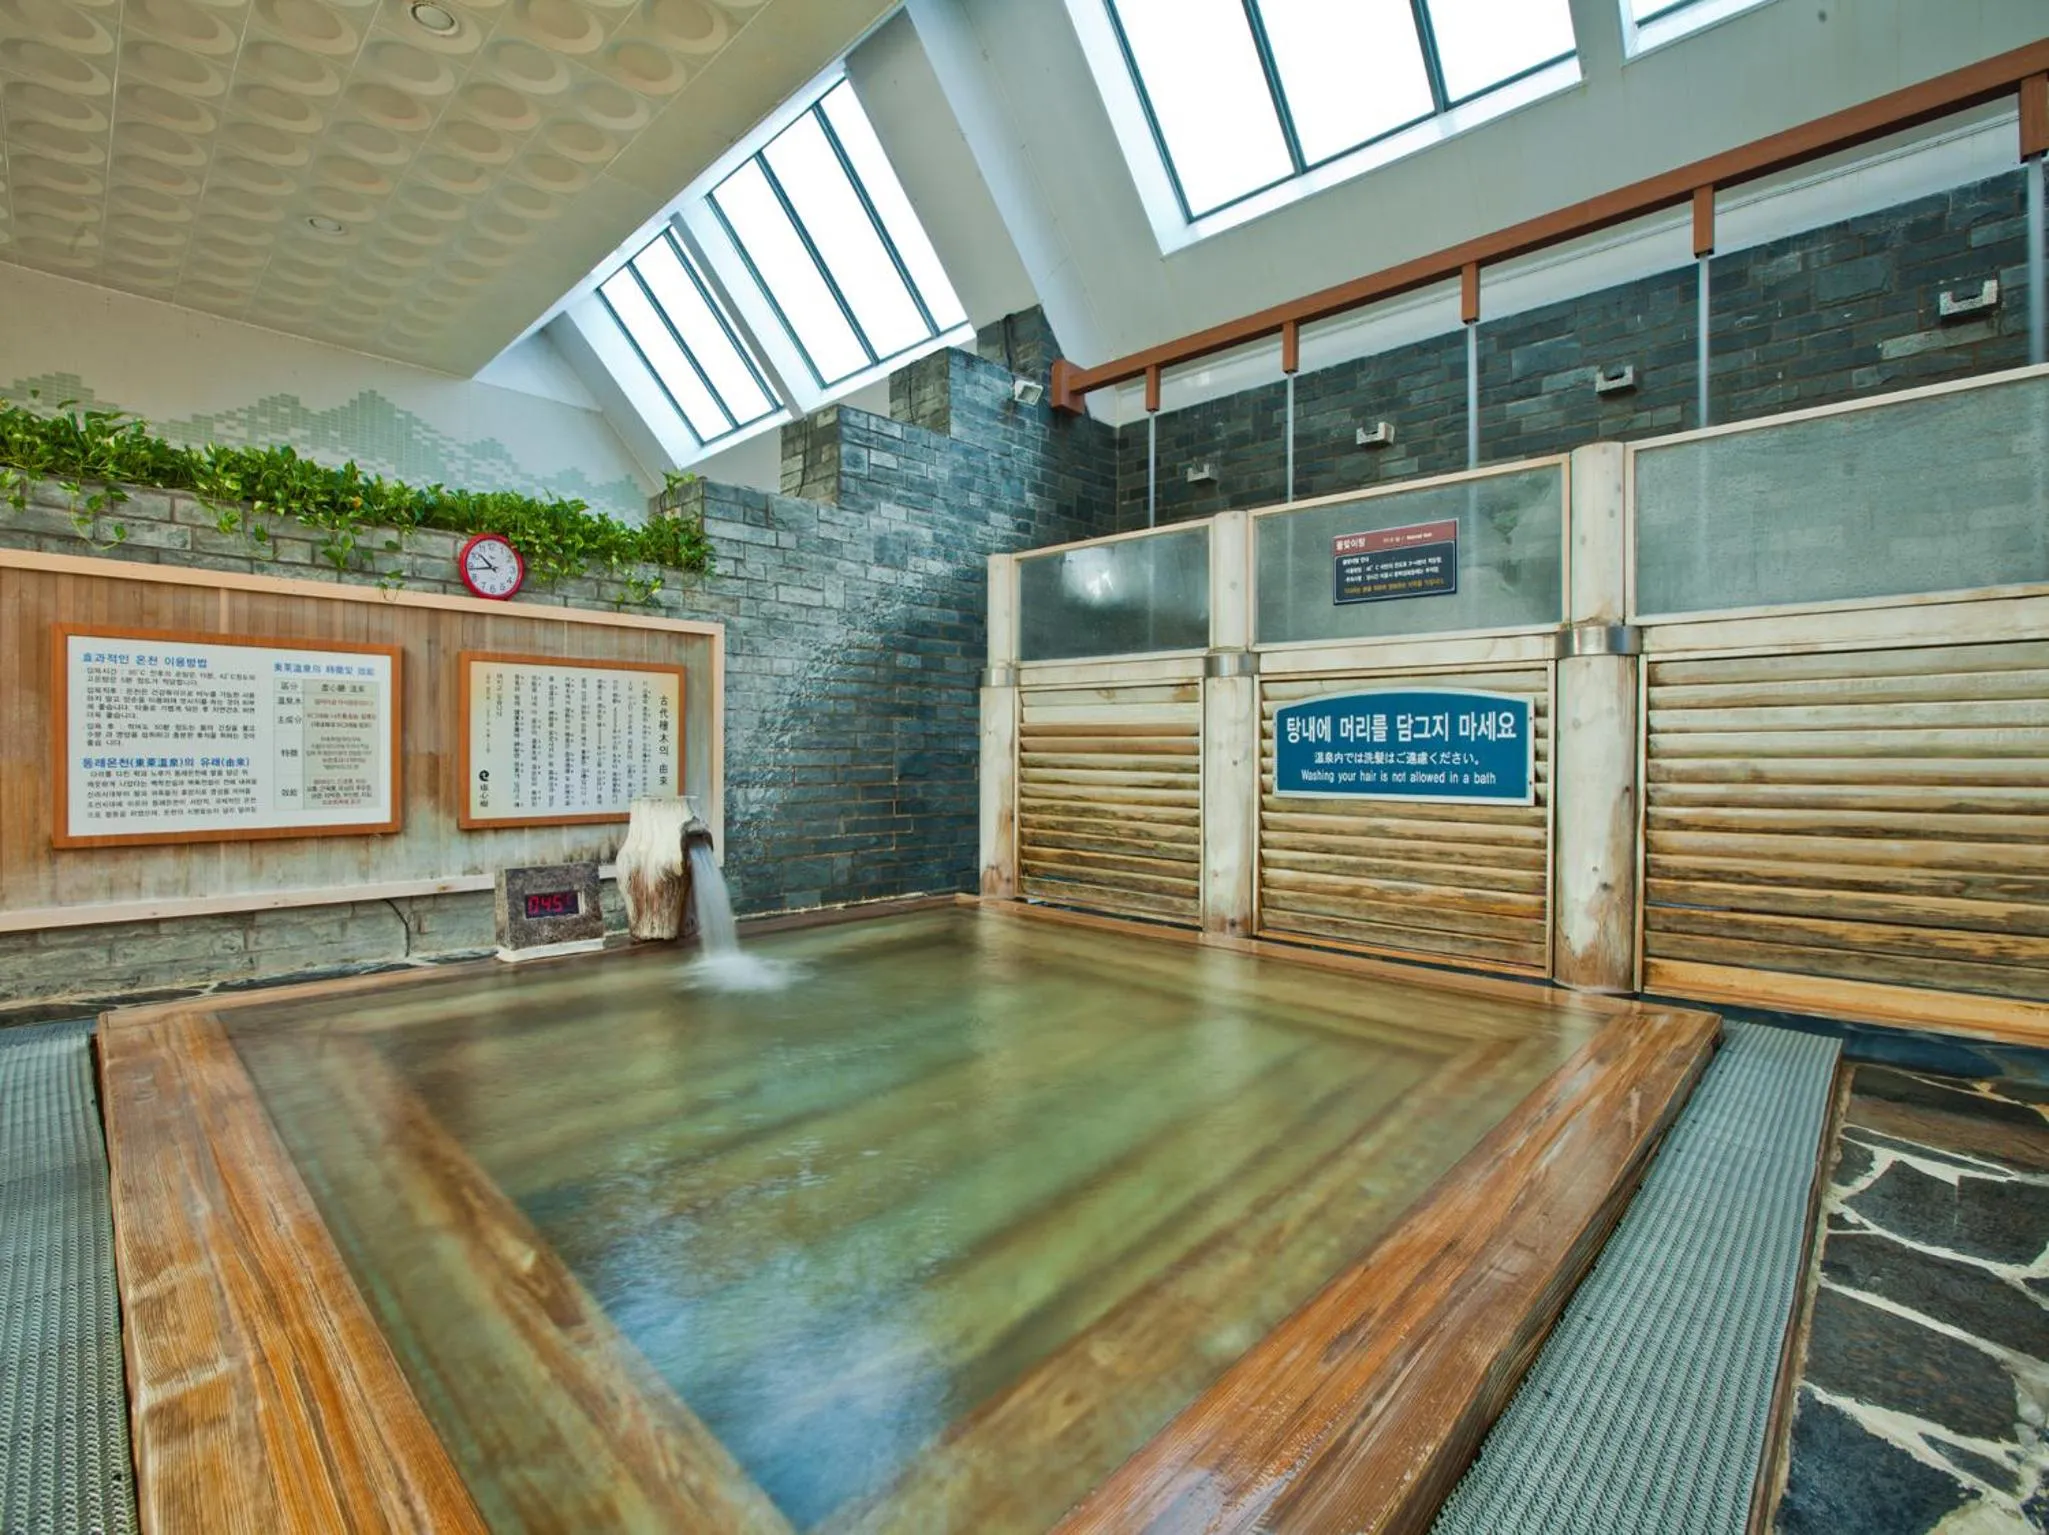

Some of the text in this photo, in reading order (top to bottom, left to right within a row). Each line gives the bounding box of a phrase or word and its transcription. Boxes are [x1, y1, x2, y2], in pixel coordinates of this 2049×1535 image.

[83, 653, 207, 668] 효과적인 온천 이용방법
[1286, 711, 1517, 744] 탕내에 머리를 담그지 마세요
[1301, 769, 1497, 784] Washing your hair is not allowed in a bath
